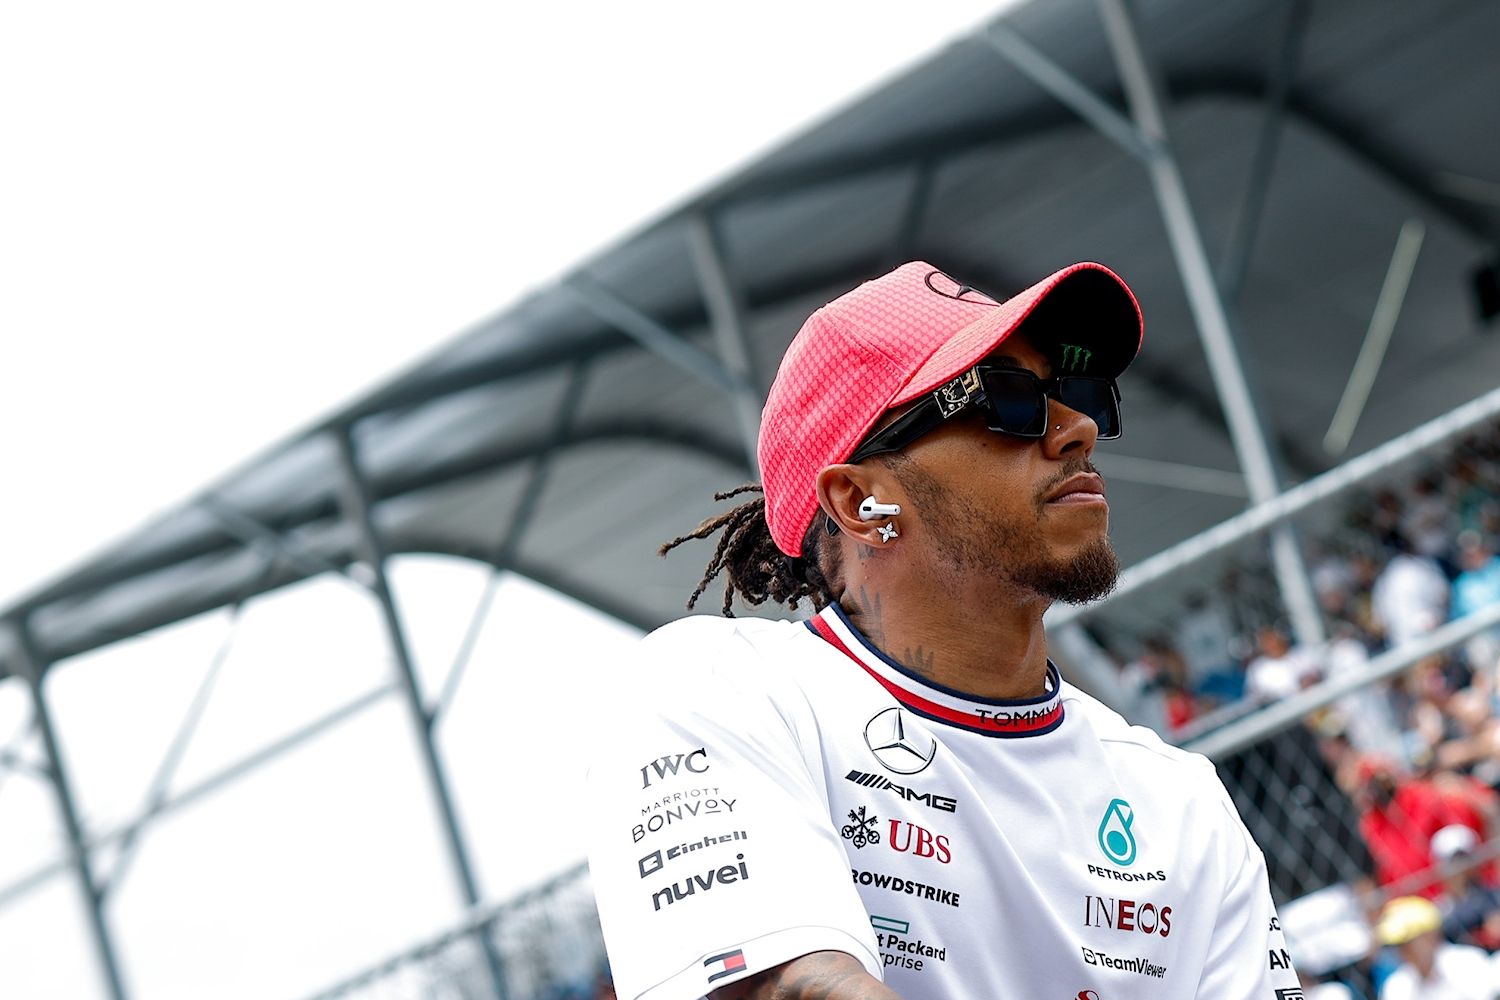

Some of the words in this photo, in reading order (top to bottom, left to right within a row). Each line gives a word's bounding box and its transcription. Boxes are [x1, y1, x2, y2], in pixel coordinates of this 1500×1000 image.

[640, 747, 710, 790] IWC
[641, 787, 720, 817] MARRIOTT
[882, 781, 957, 814] AMG
[631, 798, 737, 844] BONVOY
[666, 830, 748, 861] Einhell
[888, 818, 952, 865] UBS
[652, 853, 749, 912] nuvei
[851, 868, 960, 908] ROWDSTRIKE
[1087, 863, 1167, 882] PETRONAS
[1083, 895, 1173, 938] INEOS
[886, 933, 946, 962] Packard
[1095, 952, 1167, 979] TeamViewer
